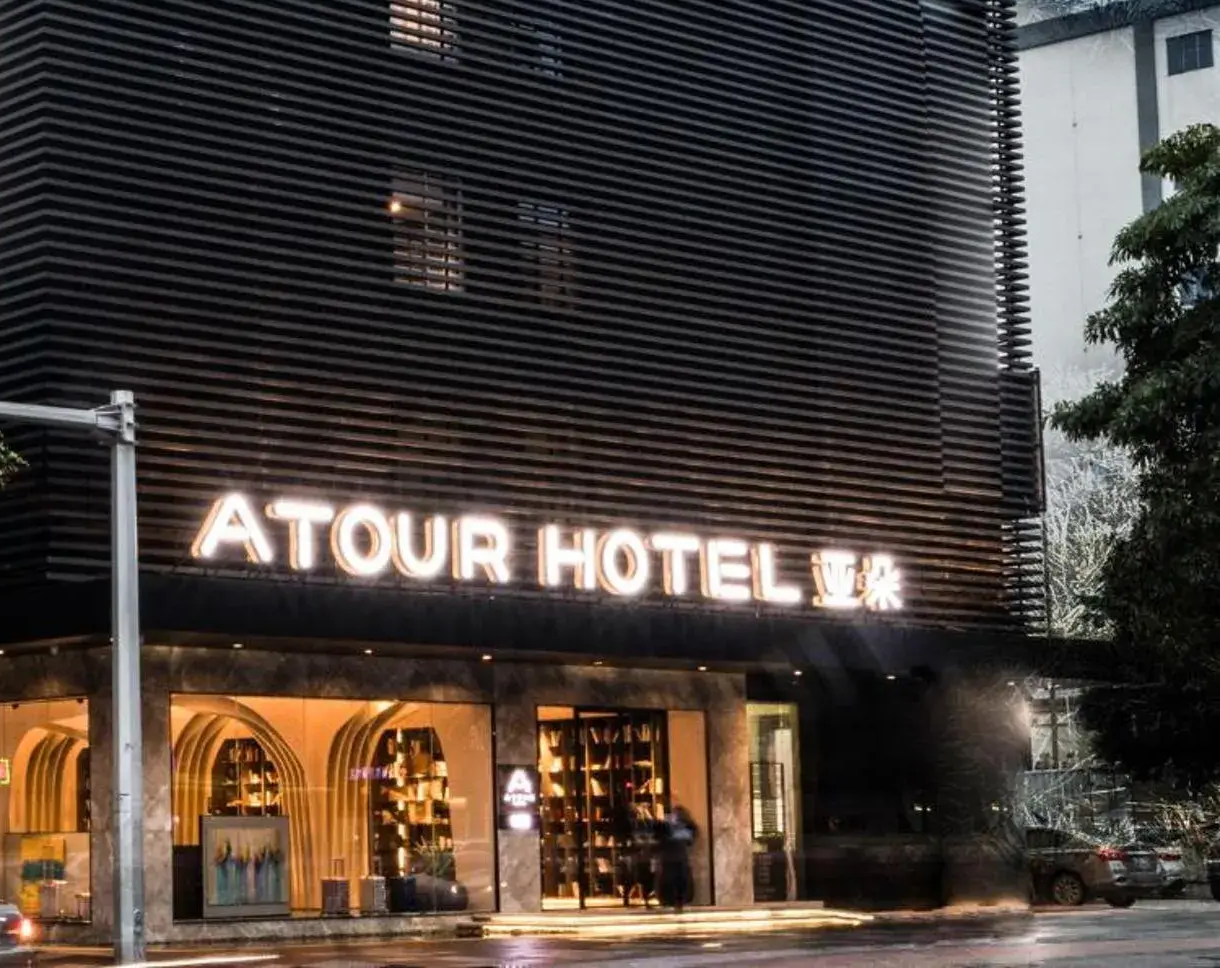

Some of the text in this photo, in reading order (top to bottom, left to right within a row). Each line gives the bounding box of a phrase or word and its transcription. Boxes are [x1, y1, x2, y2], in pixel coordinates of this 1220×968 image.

[191, 492, 803, 606] ATOUR HOTEL
[810, 548, 904, 612] 亚朵
